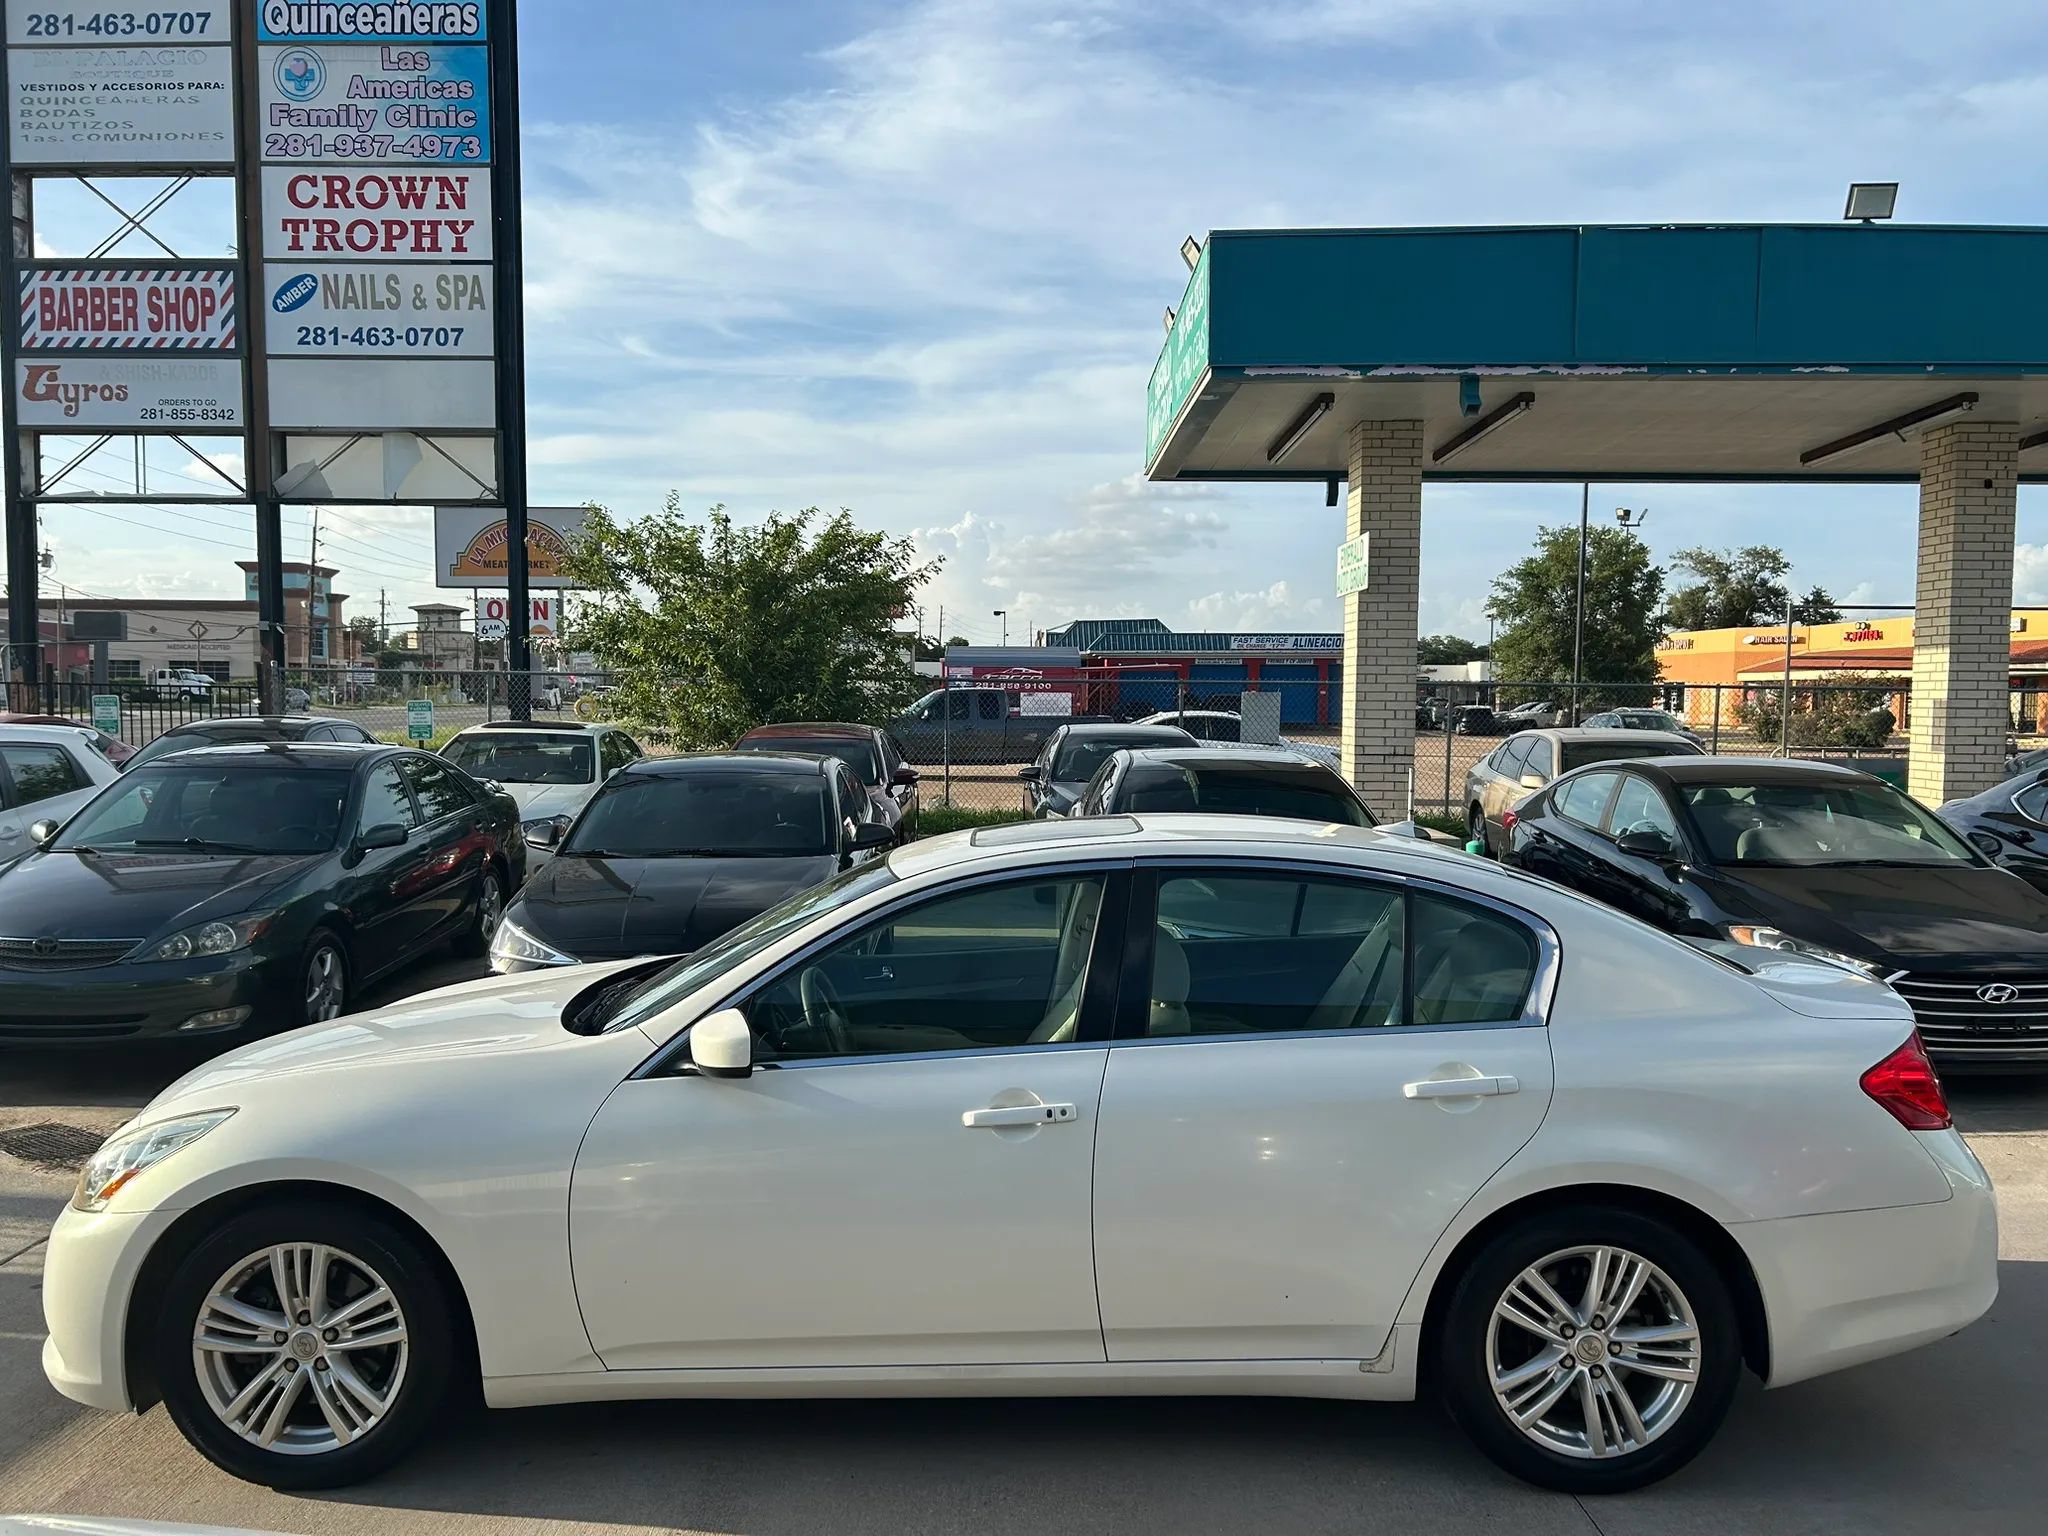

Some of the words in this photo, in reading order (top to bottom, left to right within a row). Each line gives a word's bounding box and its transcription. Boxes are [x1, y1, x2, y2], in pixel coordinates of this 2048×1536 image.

[26, 12, 212, 36] 281-463-0707
[263, 0, 479, 35] Quinceañeras
[76, 50, 207, 67] PALACIO
[380, 46, 431, 71] Las
[20, 83, 85, 92] VESTIDOS
[89, 83, 98, 91] Y
[102, 82, 185, 91] ACCESORIOS
[188, 81, 225, 90] PARA:
[347, 75, 474, 99] Americas
[19, 108, 96, 118] BODAS
[270, 103, 378, 133] Family
[385, 104, 478, 128] Clinic
[20, 121, 134, 130] BAUTIZOS
[72, 132, 225, 142] COMUNIONES
[265, 134, 481, 158] 281-937-4973
[287, 174, 469, 210] CROWN
[281, 218, 474, 253] TROPHY
[275, 277, 317, 311] AMBER
[322, 273, 401, 310] NAILS
[412, 284, 427, 310] &
[436, 273, 486, 311] SPA
[39, 287, 139, 332] BARBER
[147, 286, 216, 333] SHOP
[296, 326, 465, 347] 281-463-0707
[22, 364, 129, 418] Gyros
[140, 408, 235, 420] 281-855-8342
[468, 547, 486, 567] LA
[486, 599, 549, 621] ON
[1292, 637, 1343, 648] ALINEACIO
[1774, 635, 1798, 643] SALN
